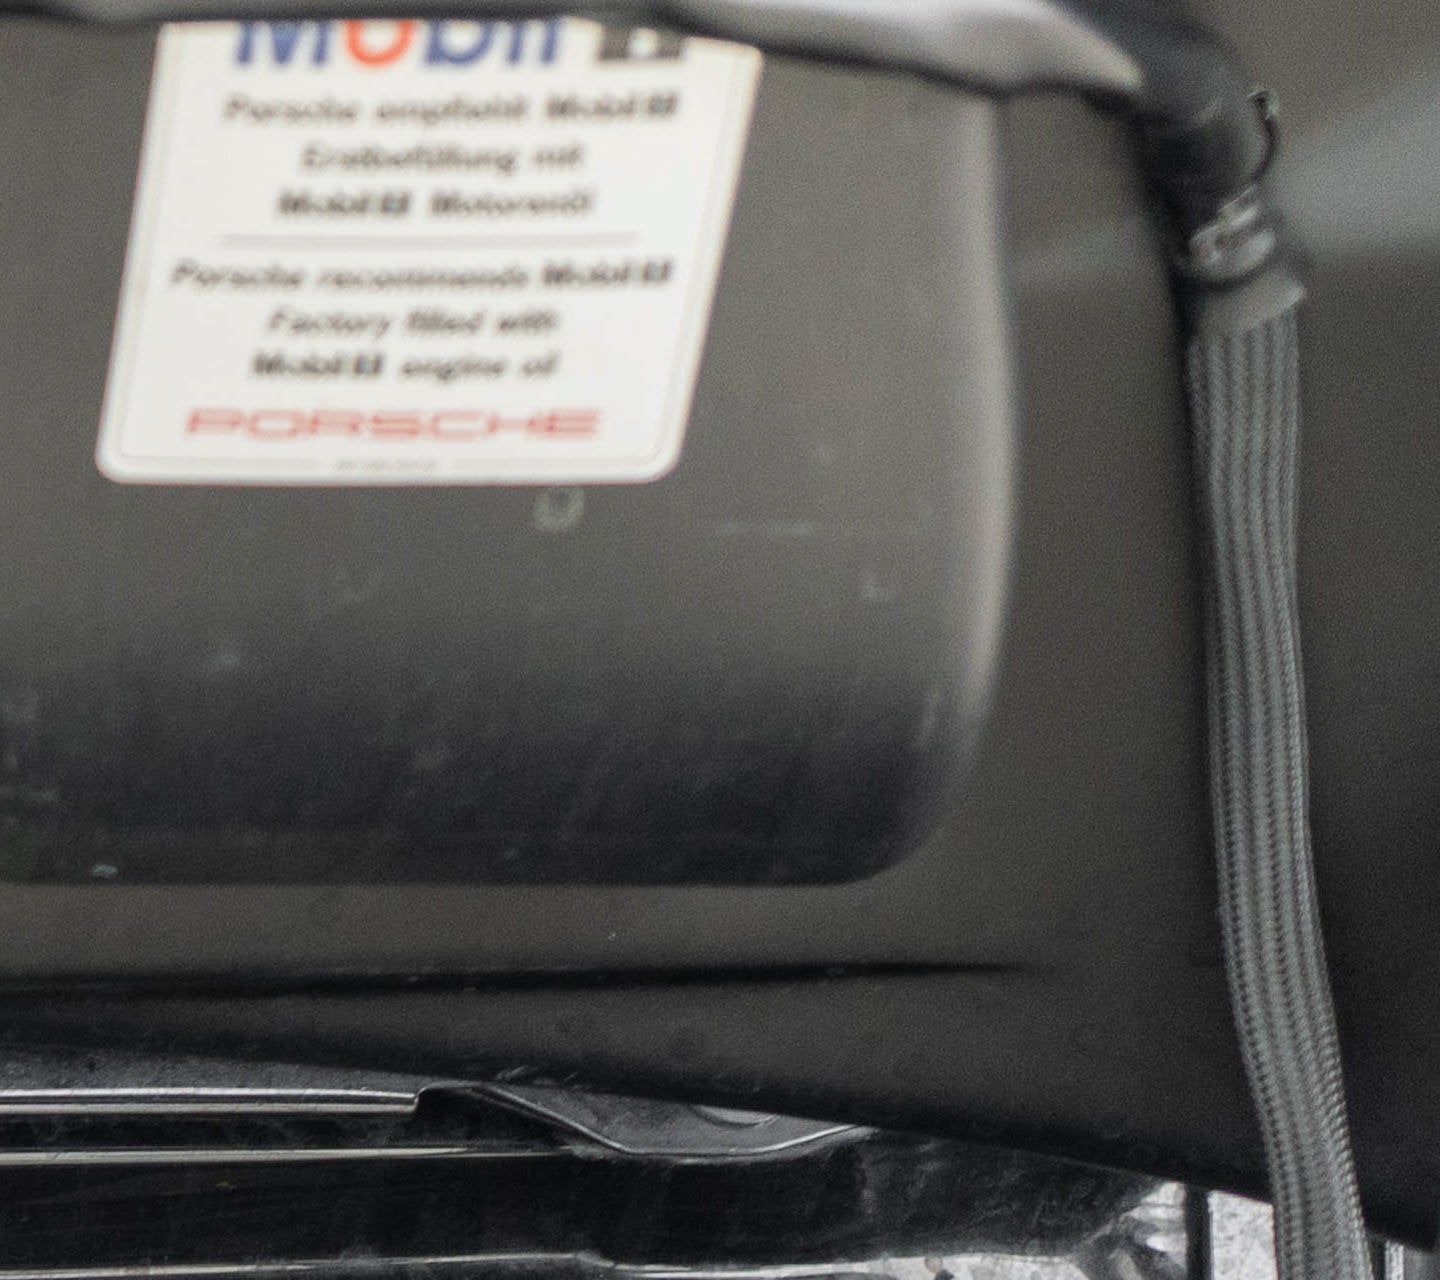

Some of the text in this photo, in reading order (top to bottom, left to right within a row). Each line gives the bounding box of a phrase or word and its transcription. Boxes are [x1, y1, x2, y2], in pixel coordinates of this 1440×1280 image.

[223, 95, 357, 126] Porsche
[172, 262, 305, 292] Porsche
[318, 263, 530, 292] recommends
[267, 308, 560, 342] Factory filled with
[401, 356, 506, 384] engine
[186, 408, 604, 442] PORSCHE
